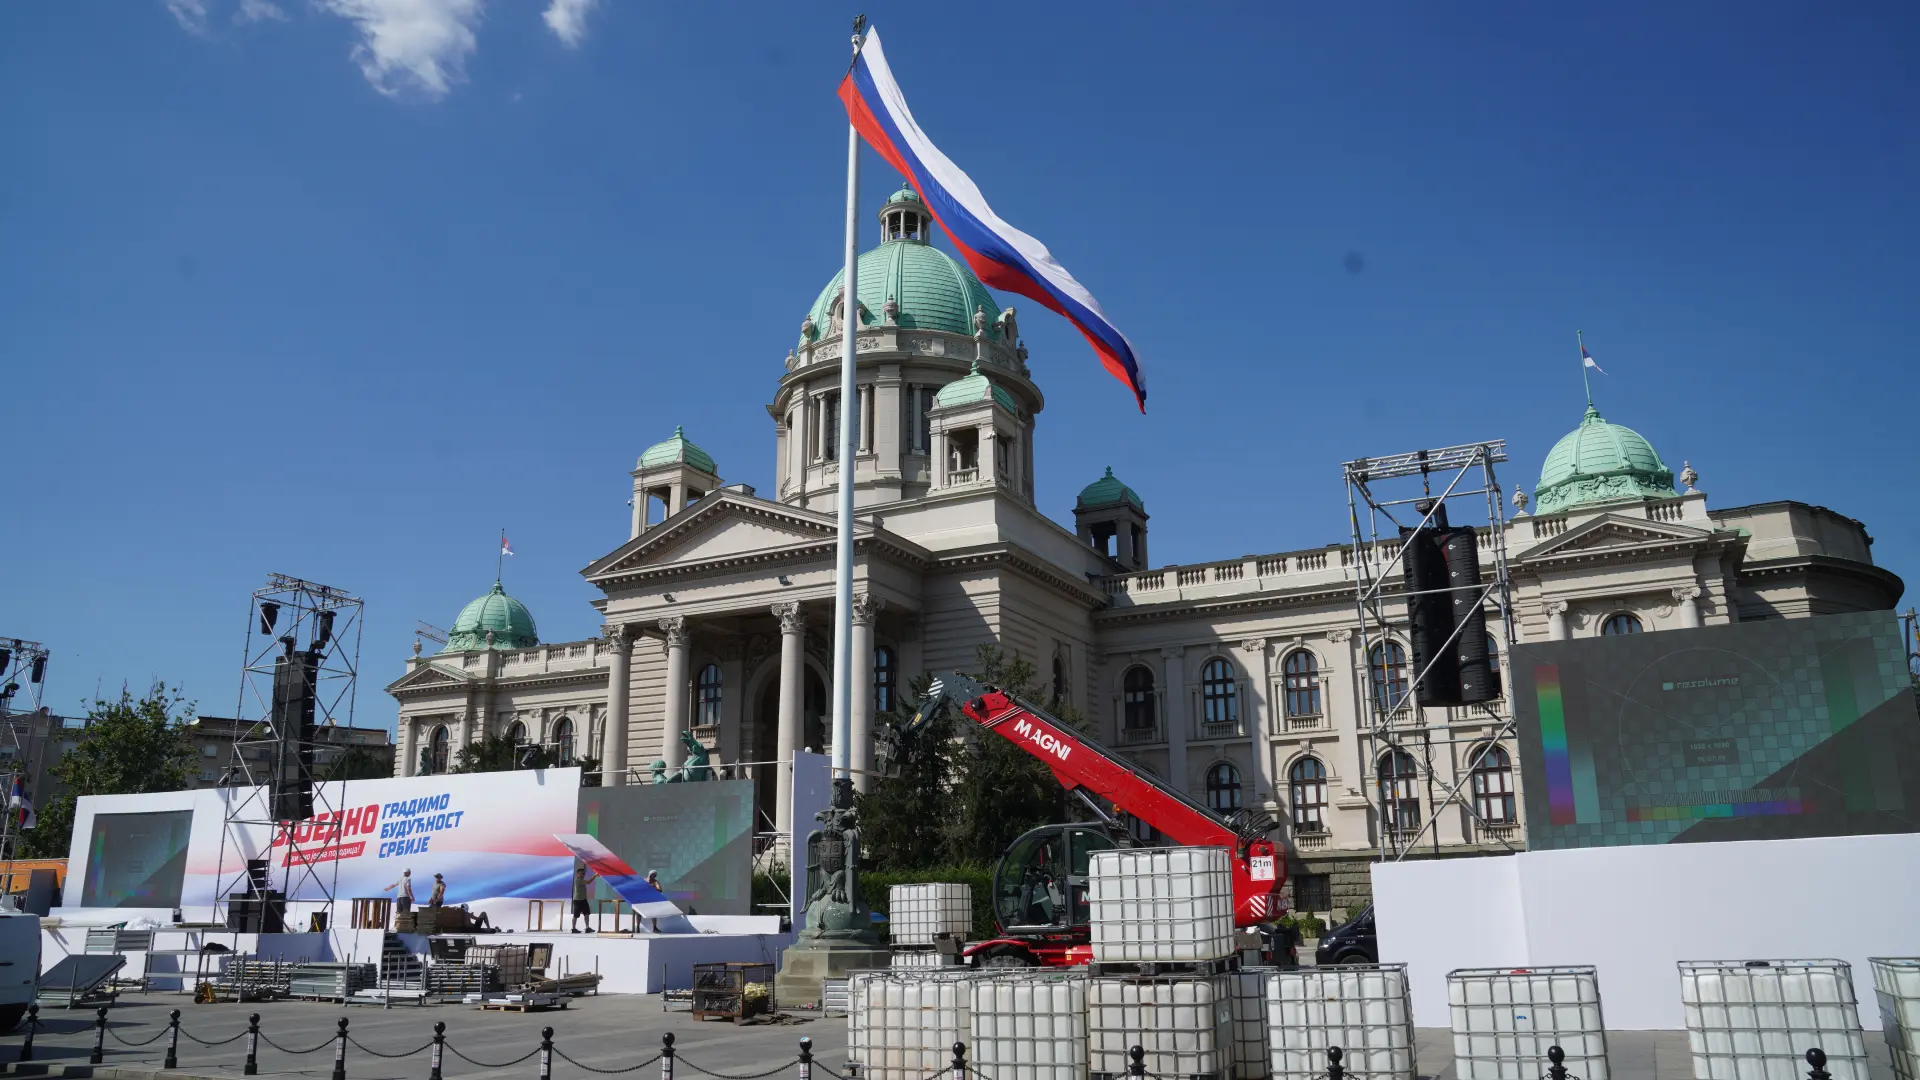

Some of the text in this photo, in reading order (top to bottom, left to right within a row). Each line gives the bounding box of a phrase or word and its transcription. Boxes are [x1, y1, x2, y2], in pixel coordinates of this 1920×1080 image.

[1676, 677, 1739, 689] resolume
[1013, 719, 1072, 761] MAGNI
[382, 793, 450, 819] ГРАДИМО
[380, 811, 464, 839] БУДУЋНОСТ
[379, 836, 431, 858] СРБИЈЕ
[1252, 859, 1272, 868] 21m
